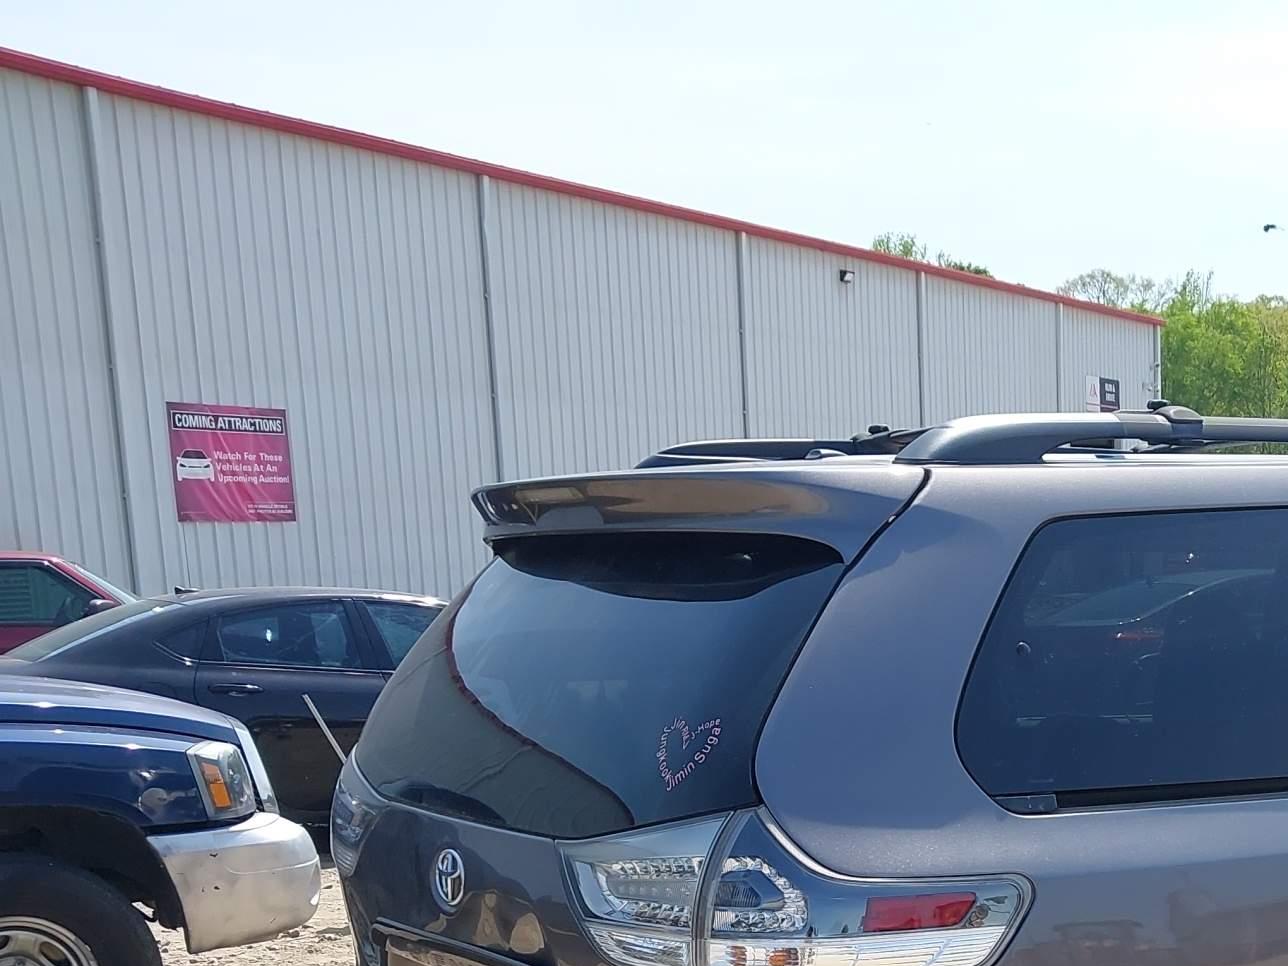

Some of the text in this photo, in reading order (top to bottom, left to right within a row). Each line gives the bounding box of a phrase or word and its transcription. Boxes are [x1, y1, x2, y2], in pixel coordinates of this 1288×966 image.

[174, 414, 282, 432] COMING ATTRACTIONS
[213, 450, 283, 462] Watch For These
[215, 462, 278, 473] Vehicles At An
[217, 473, 258, 485] Upcoming
[666, 727, 721, 792] Jimin Suga
